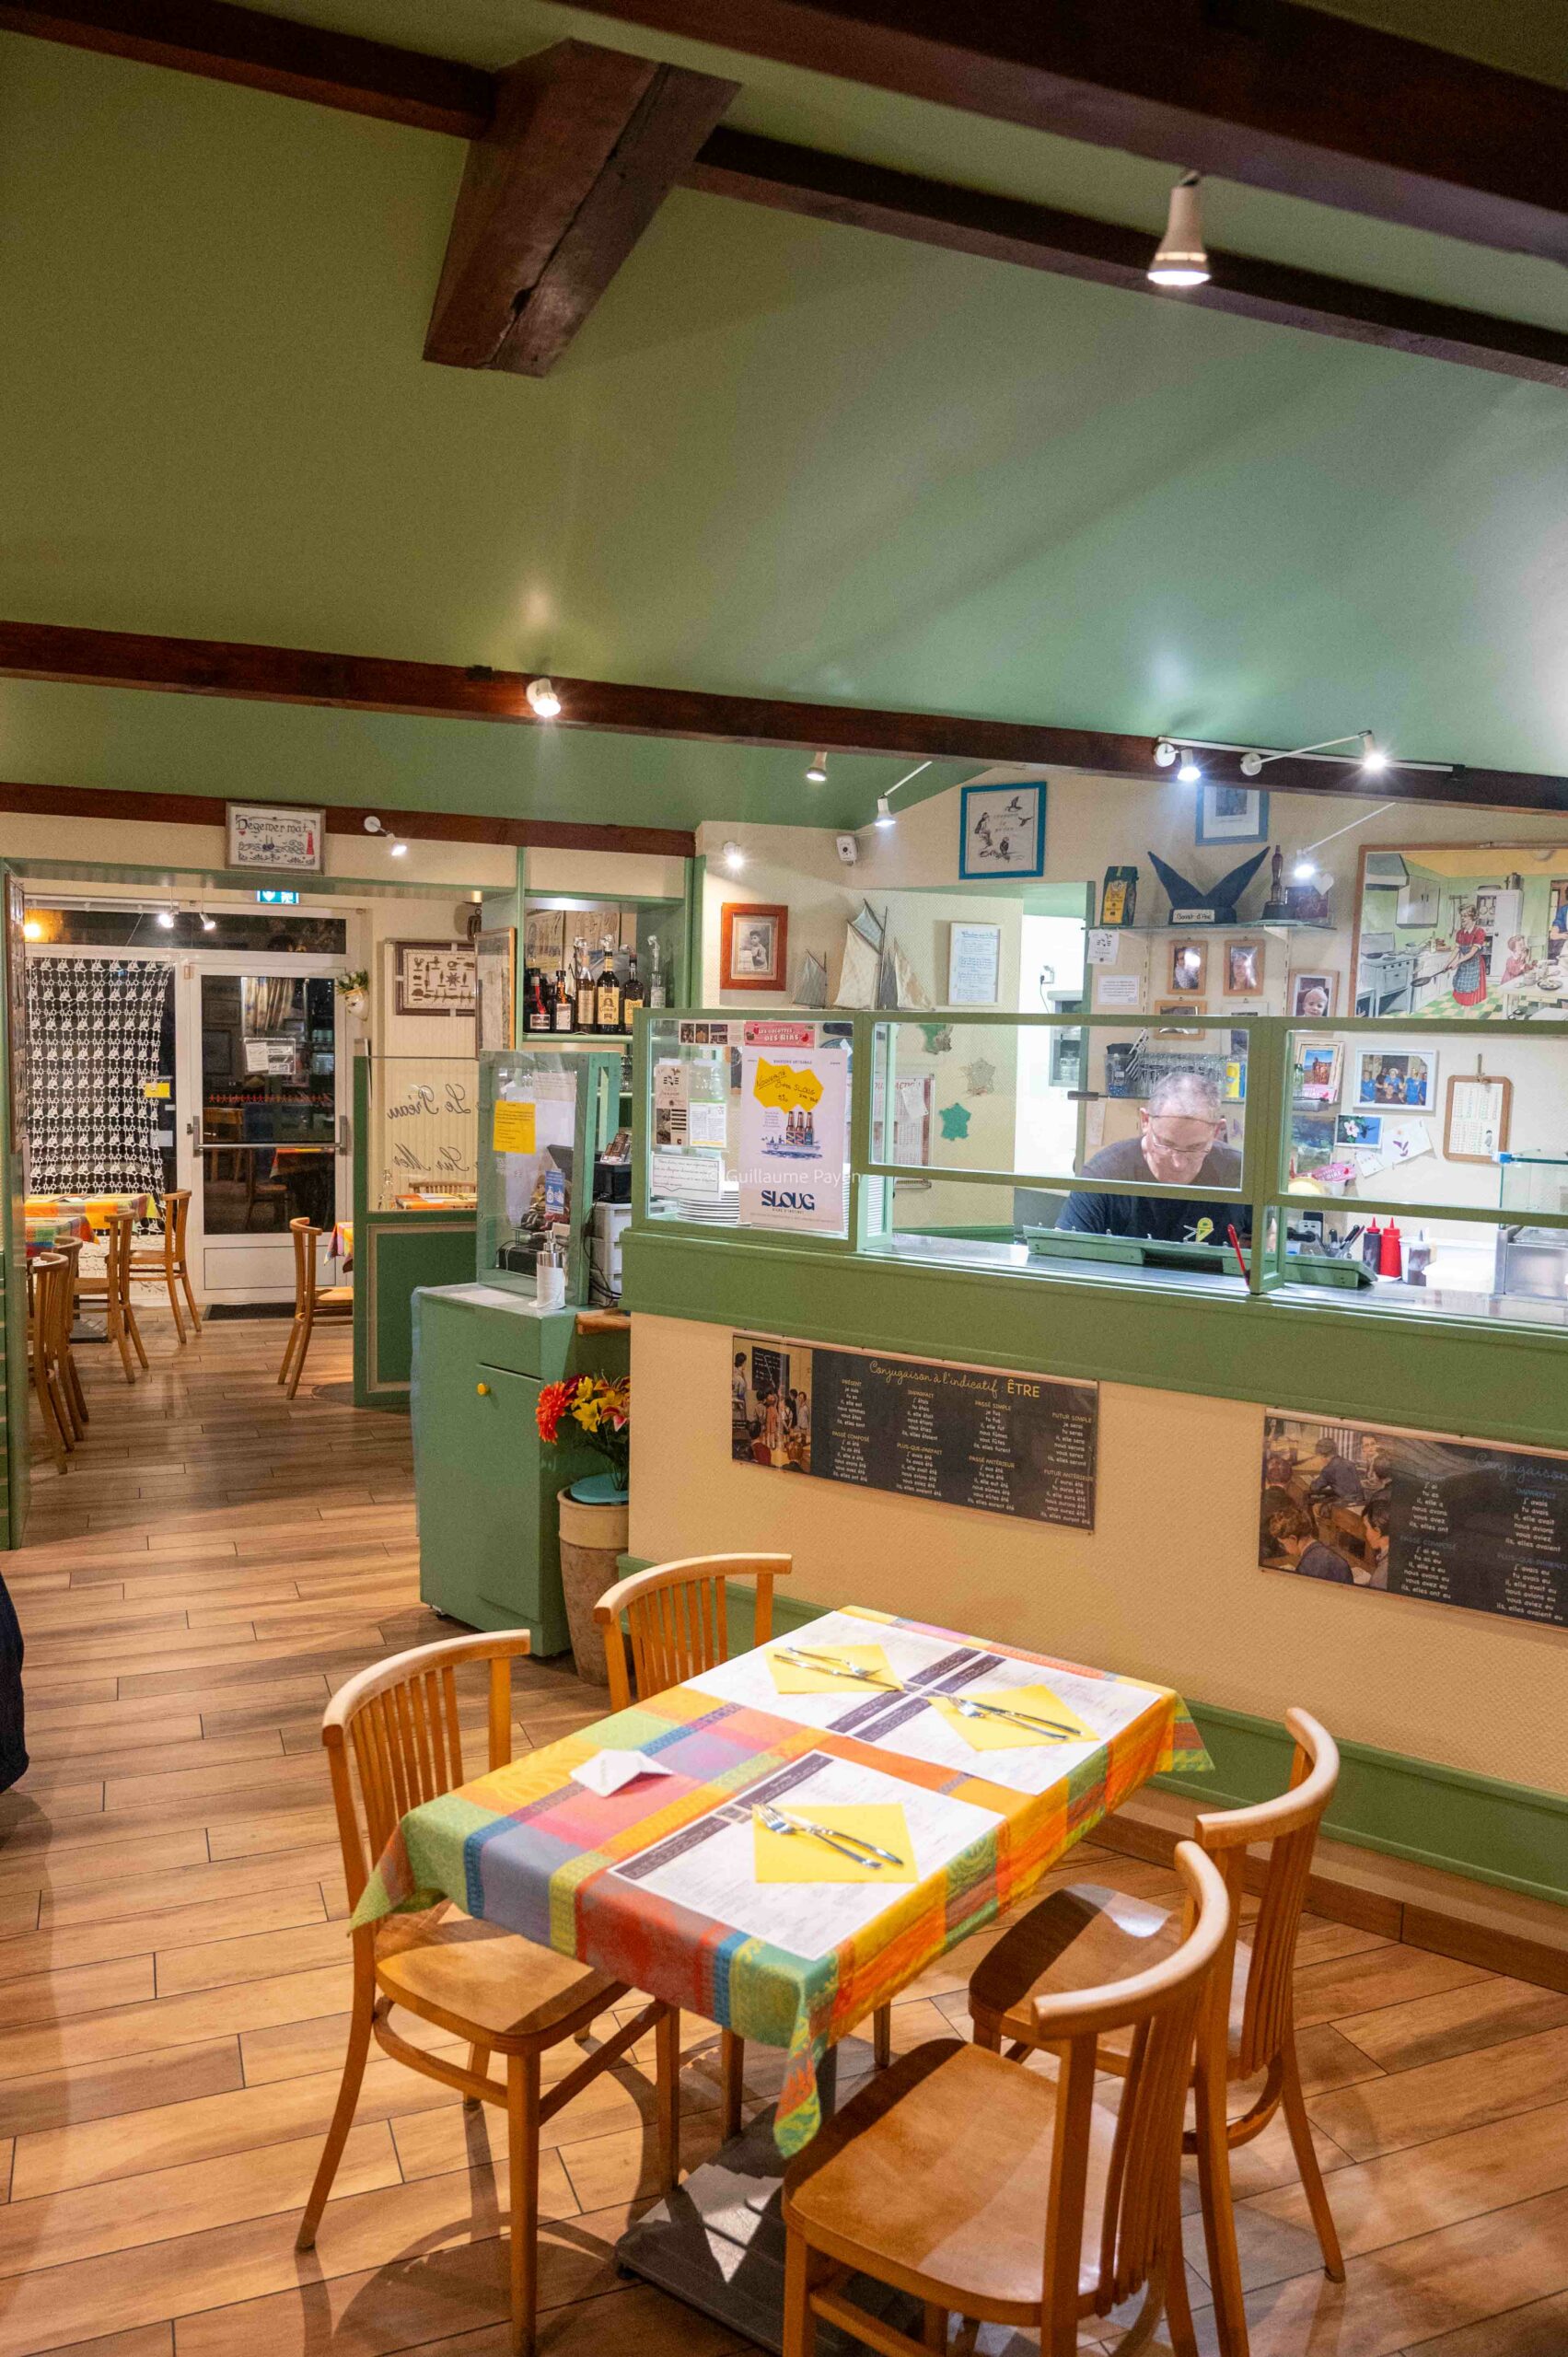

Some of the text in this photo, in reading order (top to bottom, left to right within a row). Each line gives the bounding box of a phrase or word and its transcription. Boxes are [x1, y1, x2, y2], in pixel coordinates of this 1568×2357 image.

[236, 818, 308, 833] Degemer mat
[761, 1190, 815, 1211] SLOUG
[869, 1360, 931, 1385] Conjugaison
[933, 1373, 942, 1384] à
[942, 1372, 999, 1399] l'indicatif
[1007, 1378, 1040, 1398] ÊTRE
